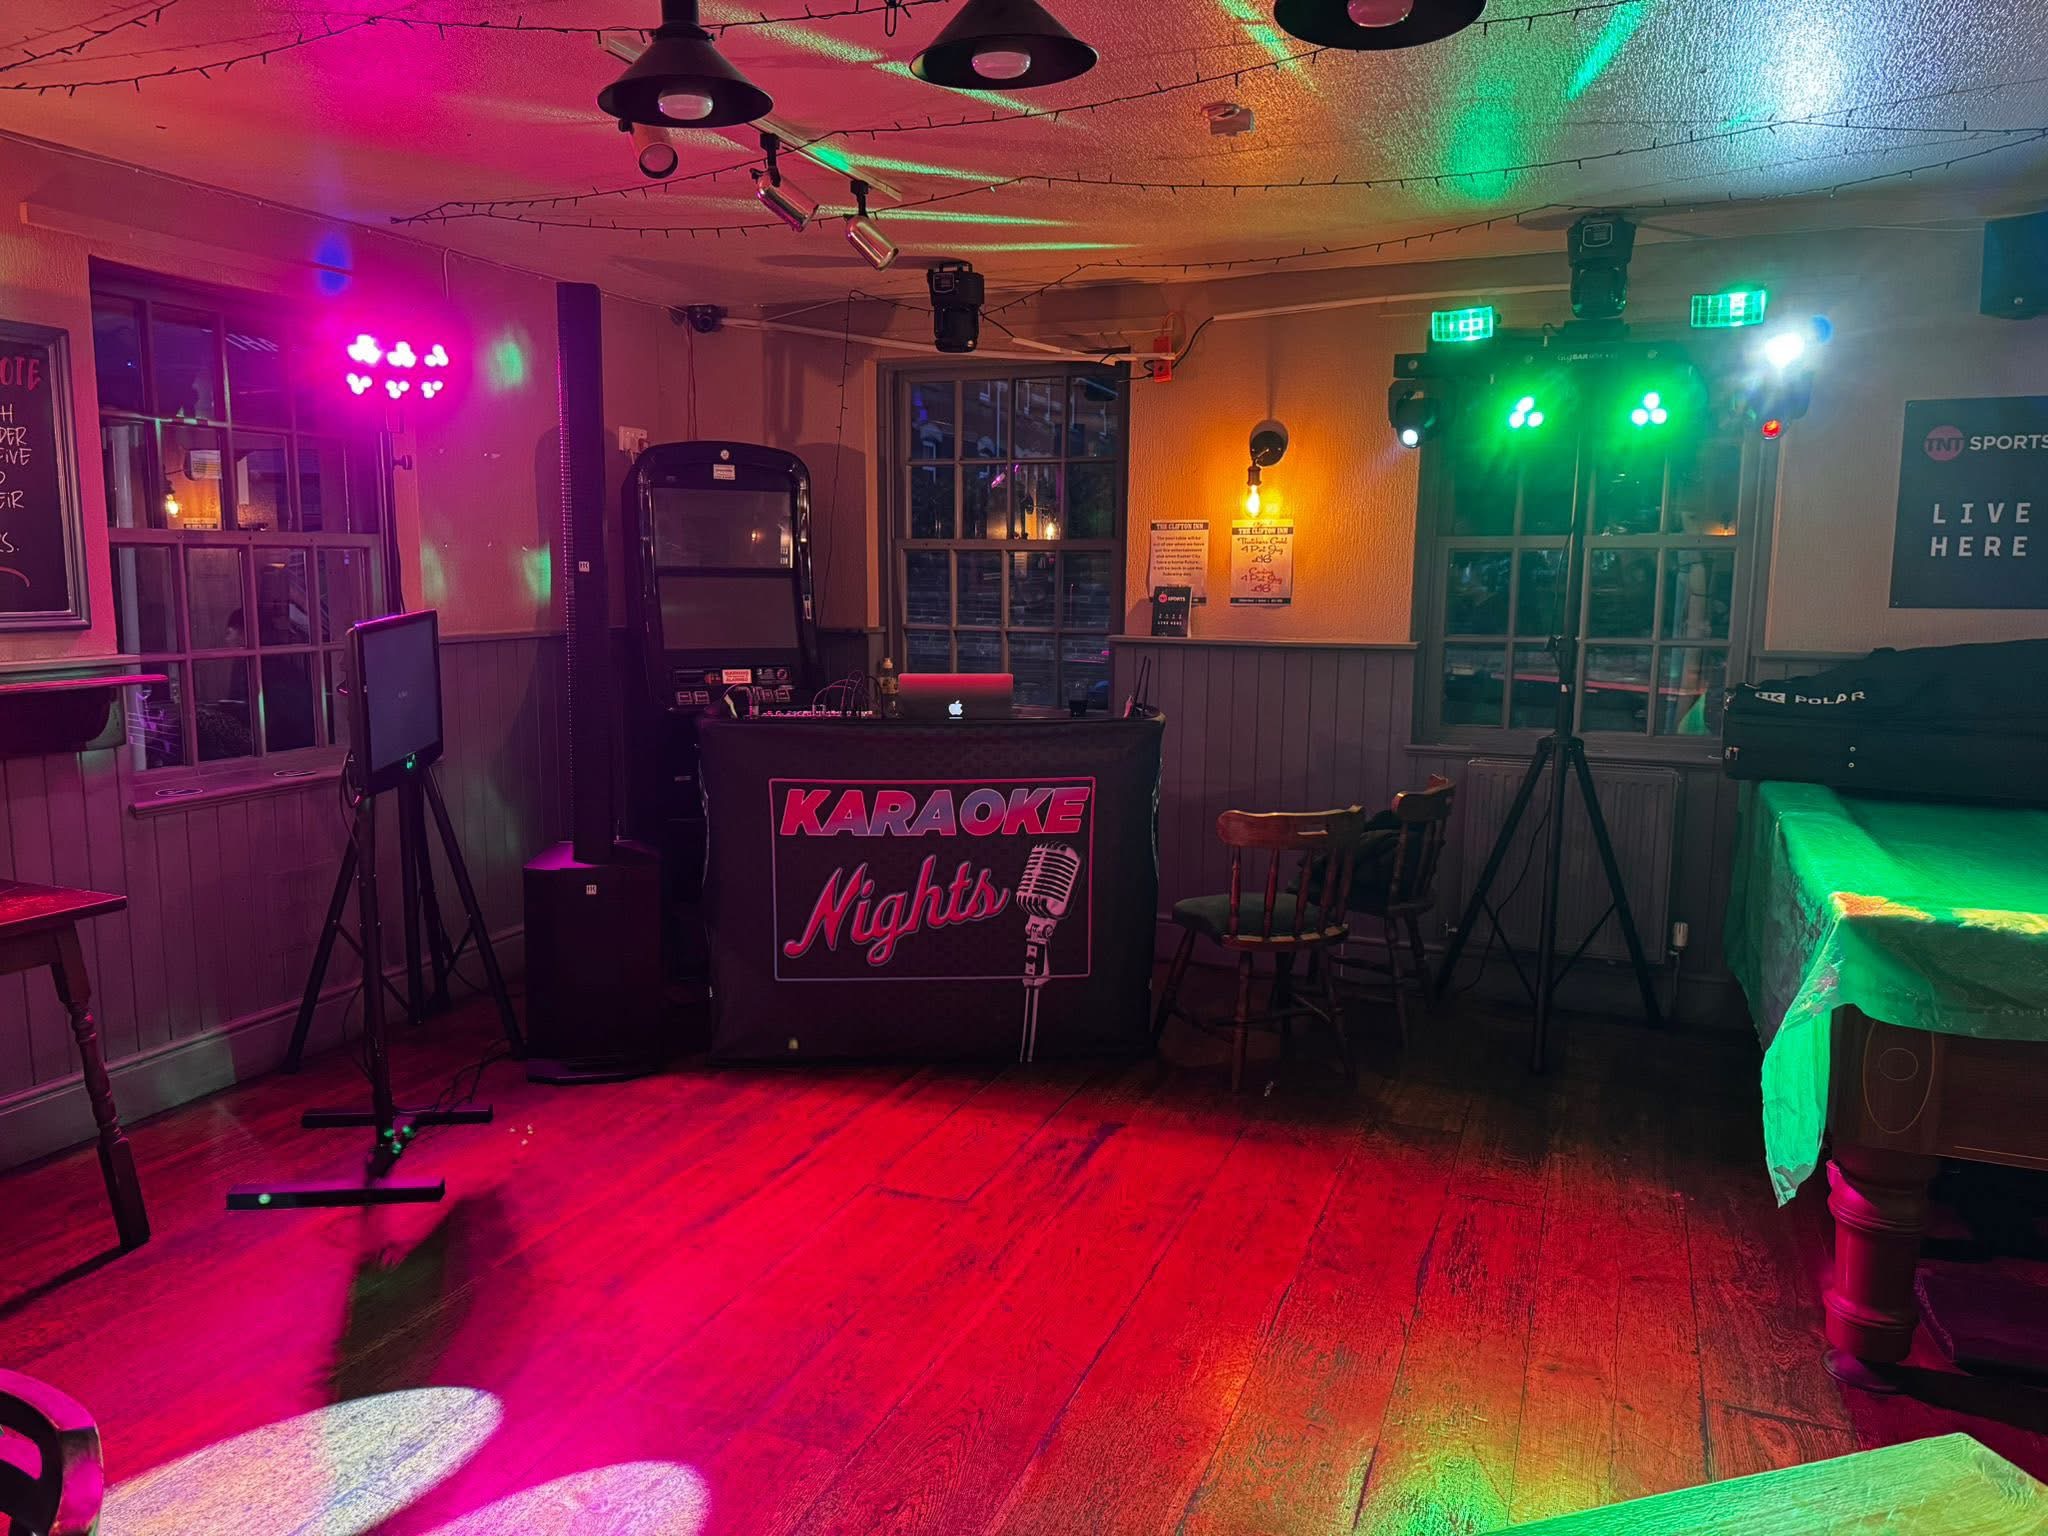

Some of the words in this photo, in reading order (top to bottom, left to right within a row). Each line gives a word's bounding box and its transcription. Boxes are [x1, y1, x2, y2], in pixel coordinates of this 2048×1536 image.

[1927, 437, 1962, 452] TNT
[1969, 434, 2048, 451] SPORTS
[1932, 502, 2032, 524] LIVE
[1930, 535, 2029, 557] HERE
[1795, 691, 1866, 705] POLAR
[780, 787, 1091, 837] KARAOKE
[783, 853, 1011, 967] Nights
